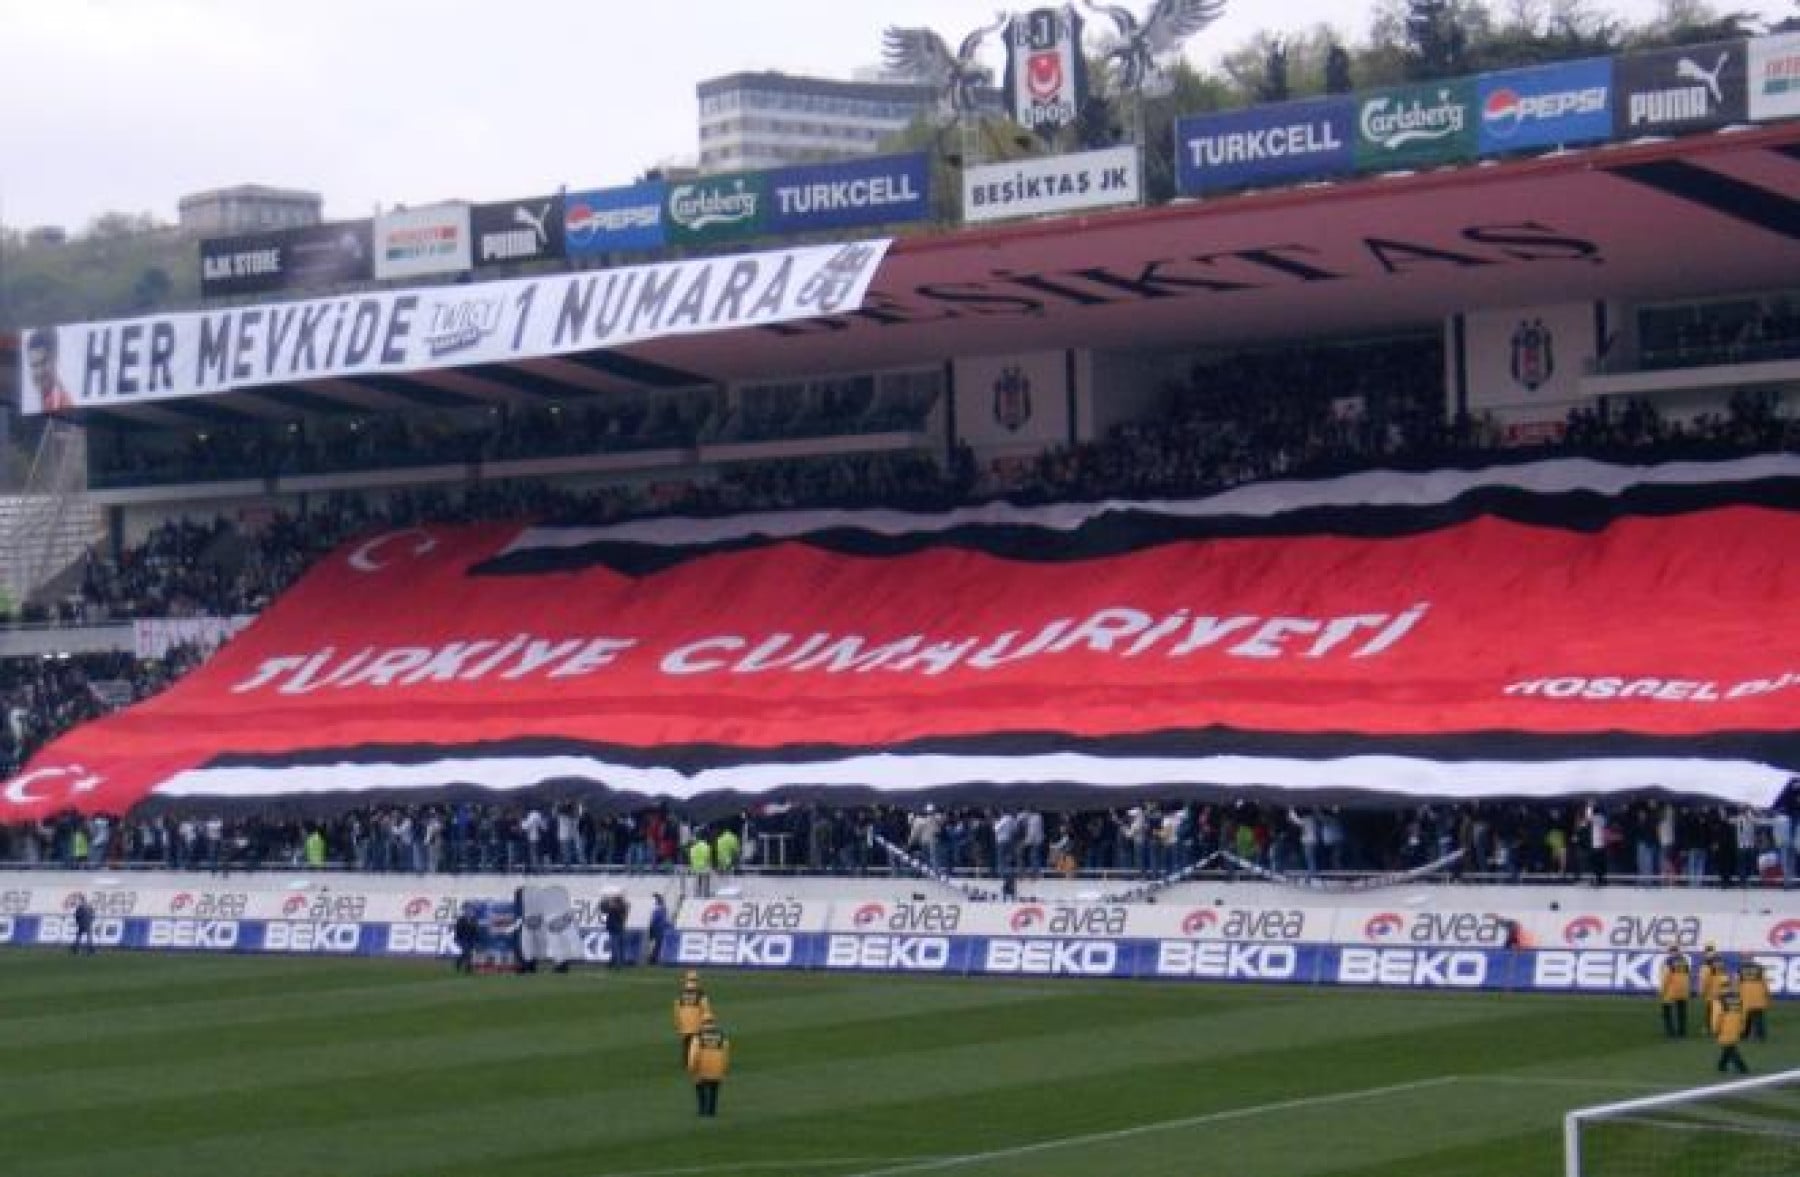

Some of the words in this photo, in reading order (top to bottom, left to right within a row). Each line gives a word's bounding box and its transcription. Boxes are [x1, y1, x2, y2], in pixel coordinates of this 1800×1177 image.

[1519, 87, 1607, 119] PEPSI
[1630, 87, 1707, 125] PUMA
[1360, 95, 1464, 150] Carlsberg
[1189, 122, 1341, 167] TURKCELL
[776, 173, 919, 214] TURKCELL
[1098, 167, 1128, 190] JK
[591, 204, 660, 229] PEPSI
[669, 180, 758, 230] Carlsberg
[482, 230, 537, 261] PUMA
[82, 322, 176, 396] HER
[510, 283, 536, 350] 1
[552, 254, 795, 346] NUMARA
[734, 900, 803, 928] avea
[888, 903, 961, 931] avea
[1049, 907, 1128, 934] avea
[1222, 910, 1305, 938] avea
[1410, 912, 1500, 942] avea
[40, 917, 123, 944] BEO
[150, 920, 238, 947] BEKO
[265, 921, 359, 949] BEKO
[388, 924, 463, 955] BEK
[1609, 915, 1702, 947] avea
[677, 933, 794, 964] BEKO
[826, 935, 949, 967] BEKO
[984, 938, 1117, 974] BEKO
[1157, 942, 1297, 977] BEKO
[1338, 947, 1487, 985] BEKO
